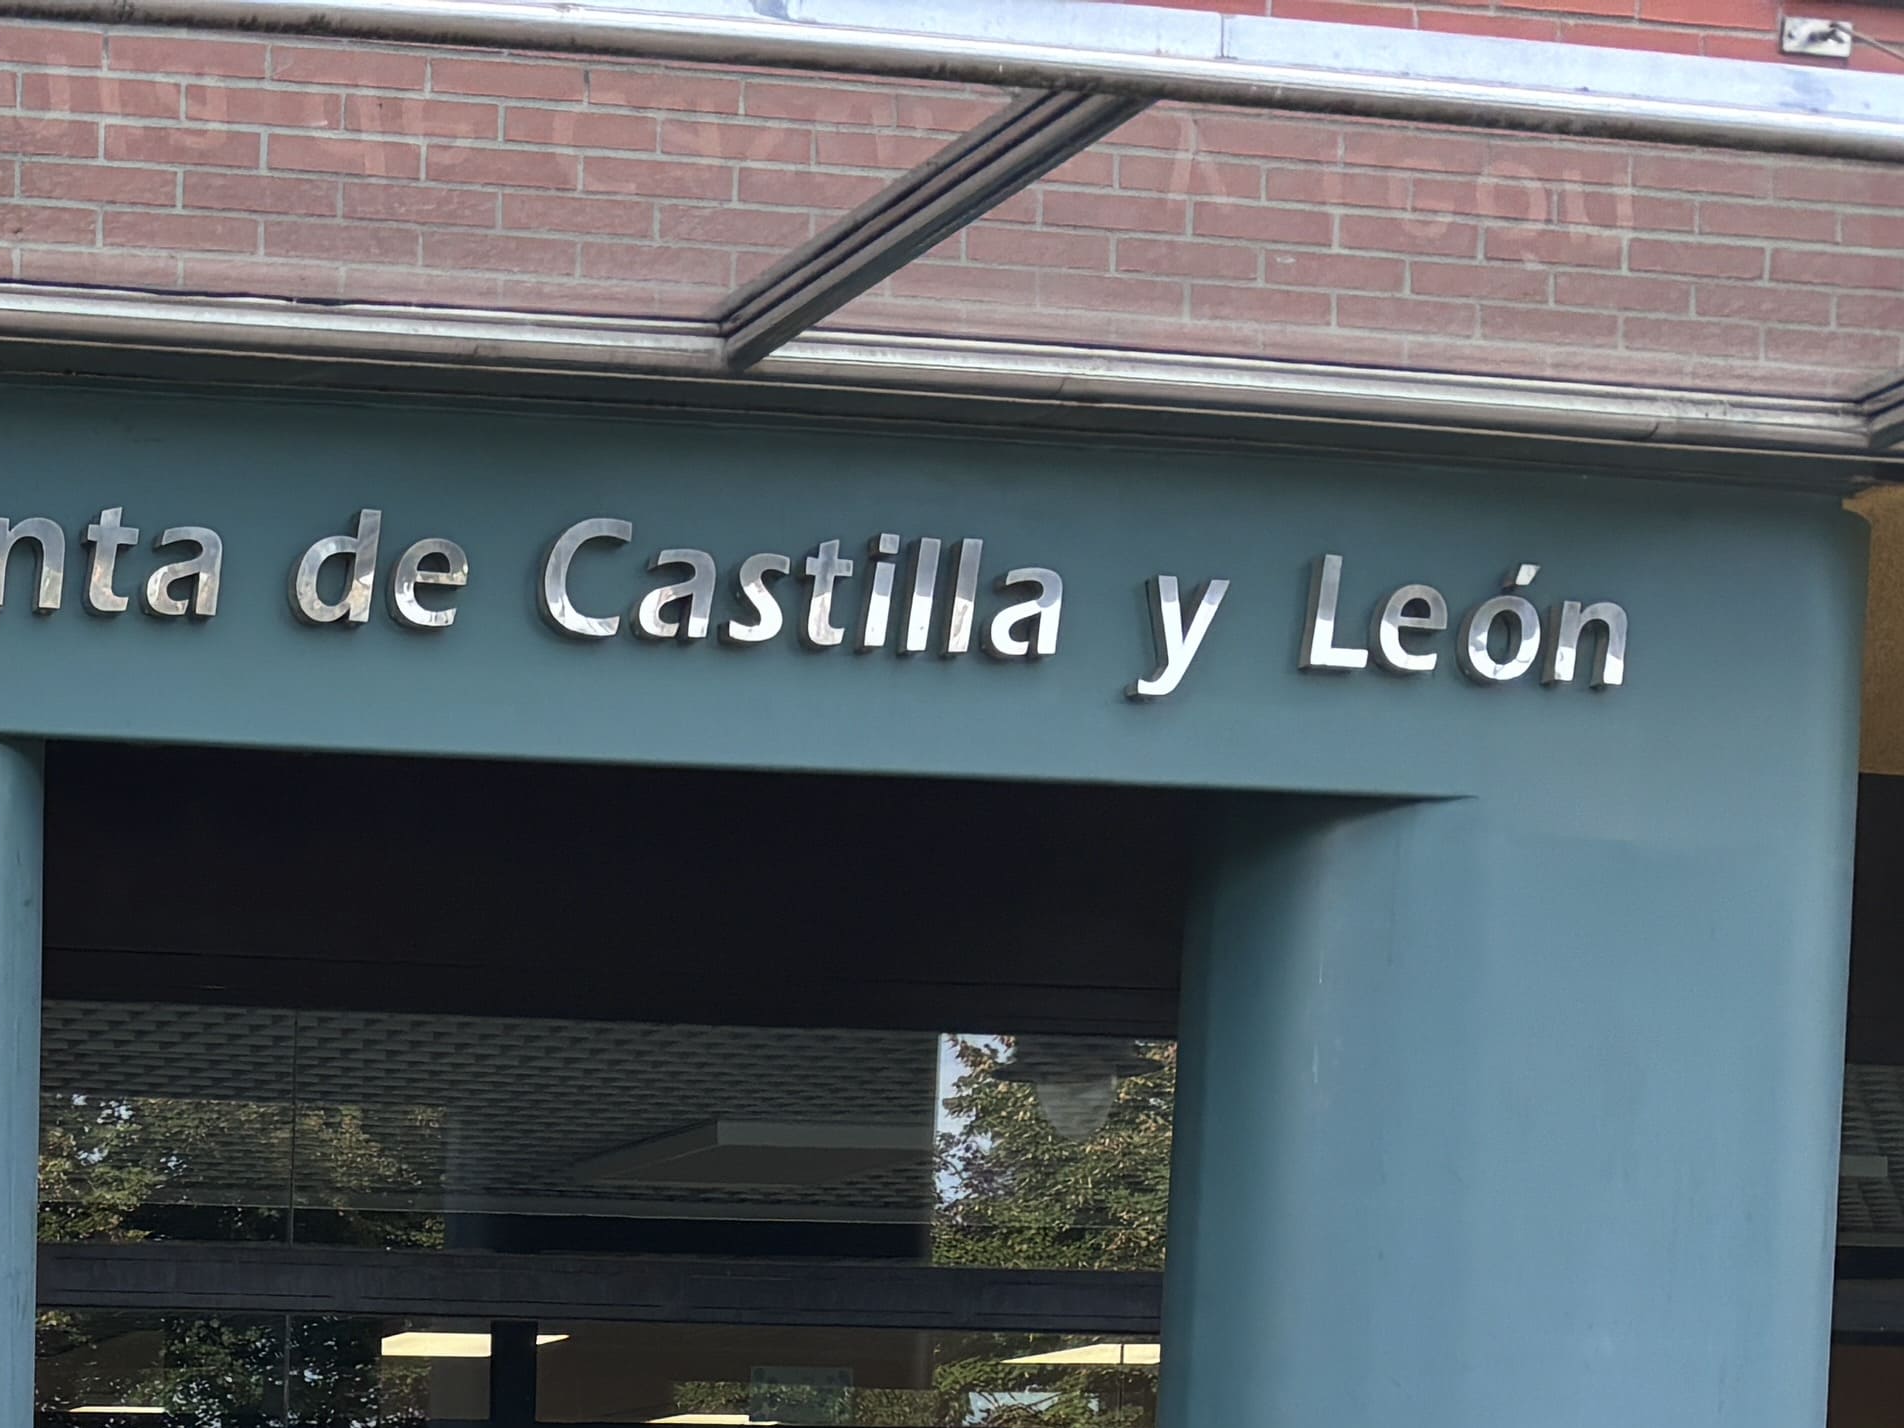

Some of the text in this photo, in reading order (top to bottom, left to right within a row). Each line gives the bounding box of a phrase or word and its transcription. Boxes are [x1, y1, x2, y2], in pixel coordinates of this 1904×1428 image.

[288, 508, 470, 630] de
[538, 517, 1064, 661] Castilla
[1126, 574, 1231, 700] y
[1298, 552, 1630, 689] León
